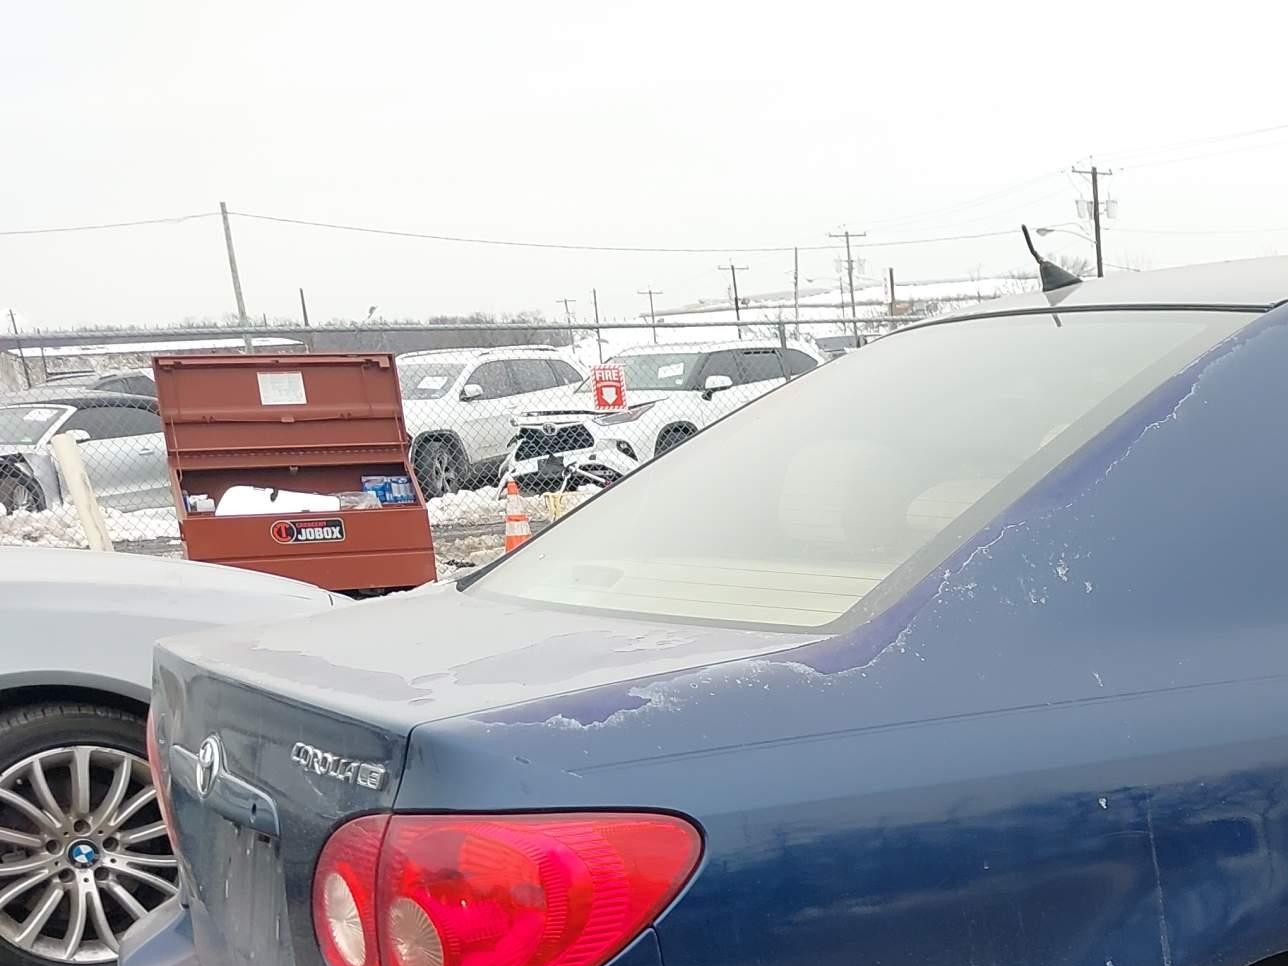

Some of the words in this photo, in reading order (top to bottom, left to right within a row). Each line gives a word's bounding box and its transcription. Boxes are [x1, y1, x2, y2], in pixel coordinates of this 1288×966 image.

[595, 369, 620, 381] FIRE
[297, 526, 342, 540] JOBOX
[290, 741, 361, 784] COROLLA
